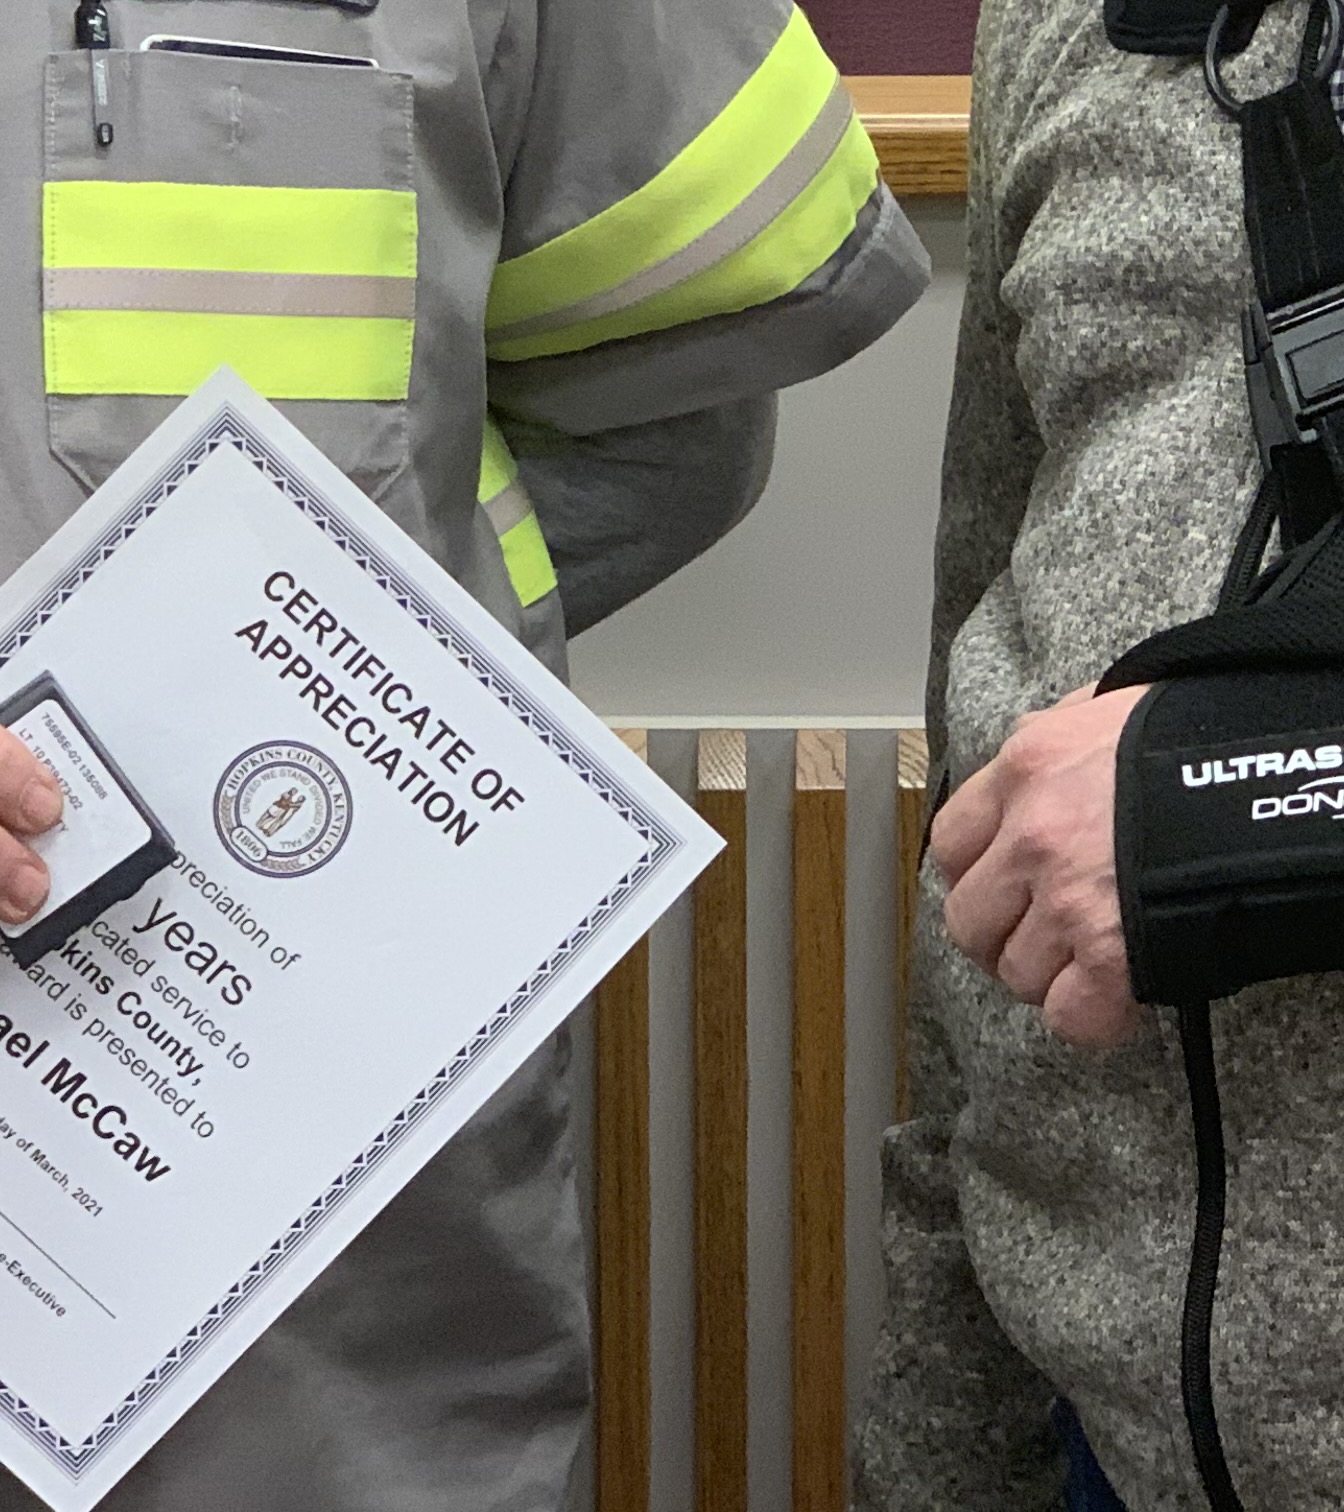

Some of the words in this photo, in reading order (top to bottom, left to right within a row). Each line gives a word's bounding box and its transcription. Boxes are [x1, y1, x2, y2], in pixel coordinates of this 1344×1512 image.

[264, 571, 475, 775] CERTIFICATE
[471, 769, 524, 812] OF
[234, 620, 479, 846] APPRECIATION
[227, 749, 282, 790] HOPKINS
[308, 792, 345, 862] KENTUCKY
[243, 779, 261, 814] UNITED
[261, 769, 277, 782] WE
[279, 769, 311, 786] STAND
[309, 784, 324, 825] DIVIDED
[236, 829, 261, 857] 1806
[279, 839, 303, 849] FALL
[301, 826, 317, 840] WE
[131, 897, 251, 1005] years
[269, 947, 301, 970] of
[59, 938, 114, 995] kins
[116, 991, 203, 1086] County,
[91, 921, 155, 977] cated
[150, 975, 225, 1046] service
[226, 1042, 249, 1069] to
[63, 993, 87, 1020] is
[81, 1018, 195, 1116] presented
[190, 1111, 213, 1138] to
[40, 1057, 170, 1182] McCaw
[15, 1138, 34, 1152] of
[29, 1149, 71, 1191] March,
[71, 1187, 102, 1216] 2021
